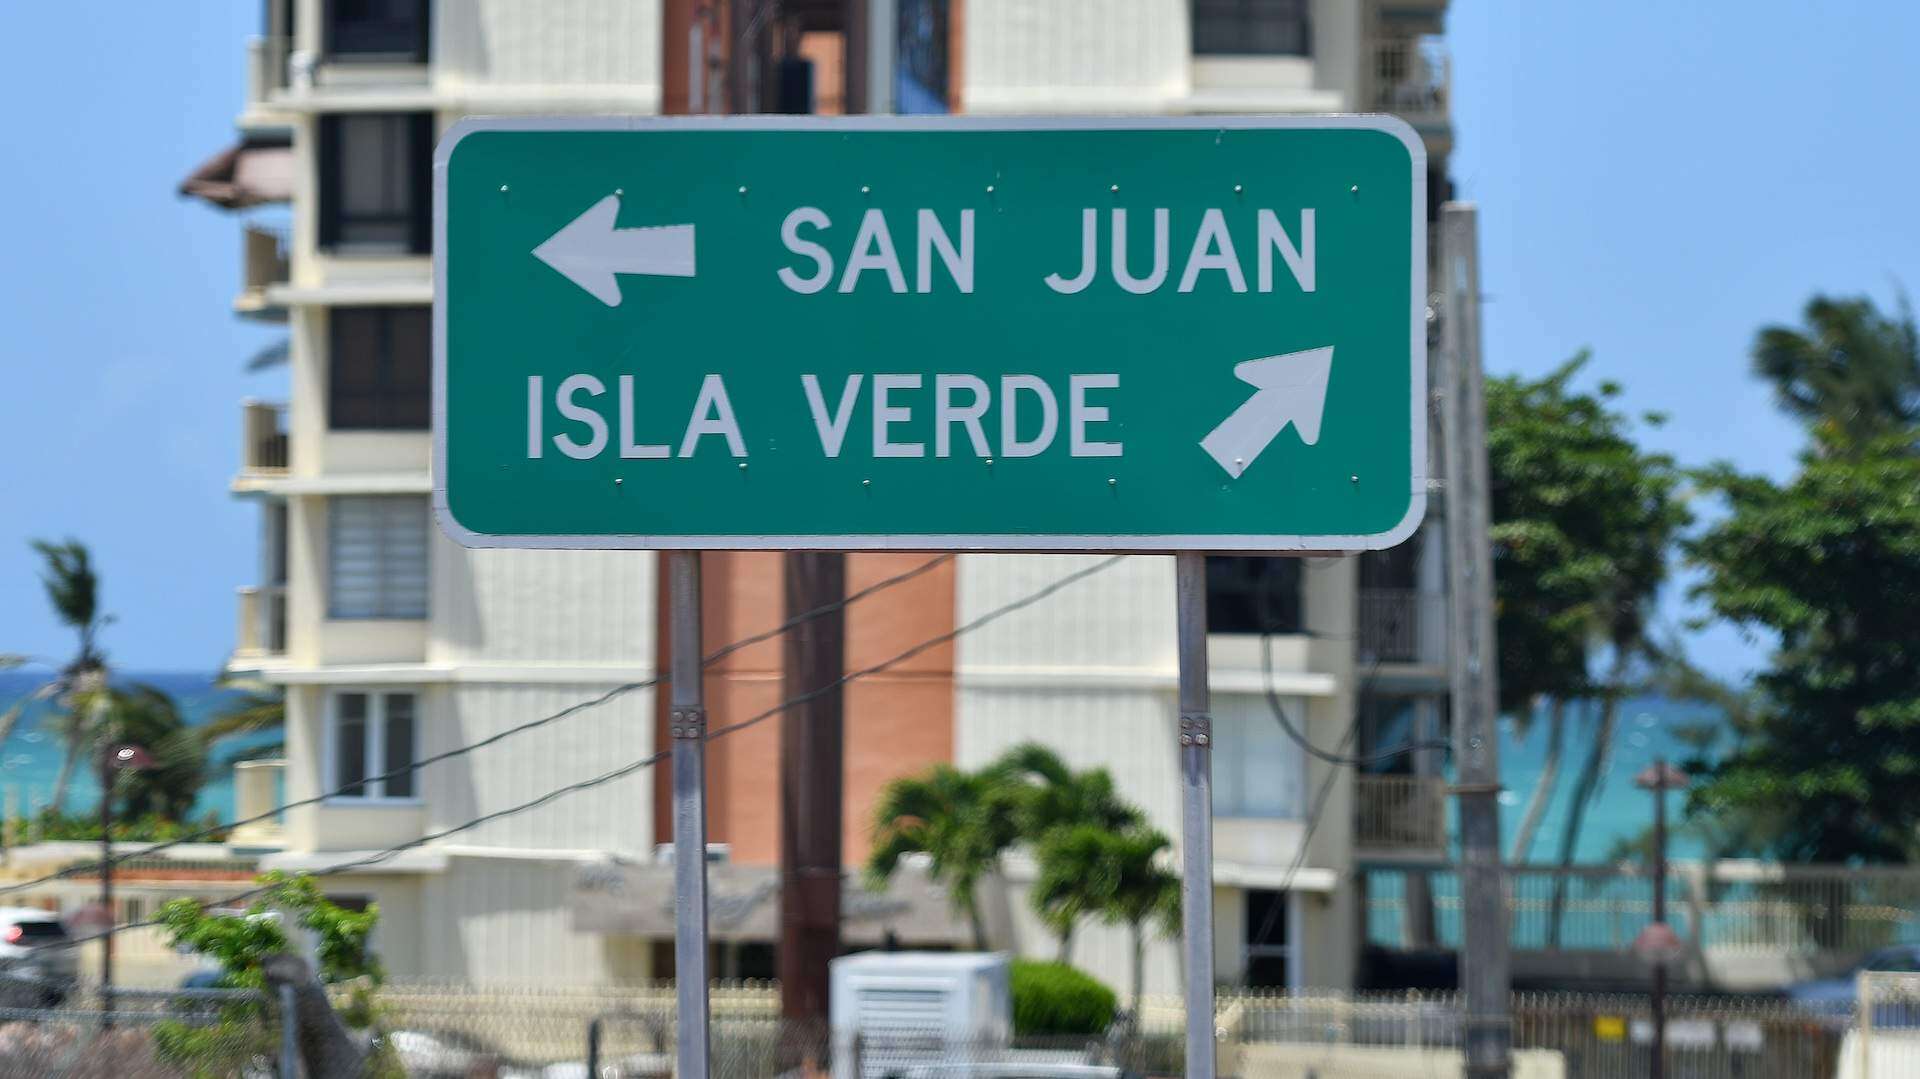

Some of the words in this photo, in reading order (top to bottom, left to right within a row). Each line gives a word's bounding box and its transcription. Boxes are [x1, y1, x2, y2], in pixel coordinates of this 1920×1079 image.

[778, 207, 975, 295] SAN
[1044, 208, 1316, 295] JUAN
[527, 373, 748, 460] ISLA
[802, 373, 1123, 459] VERDE
